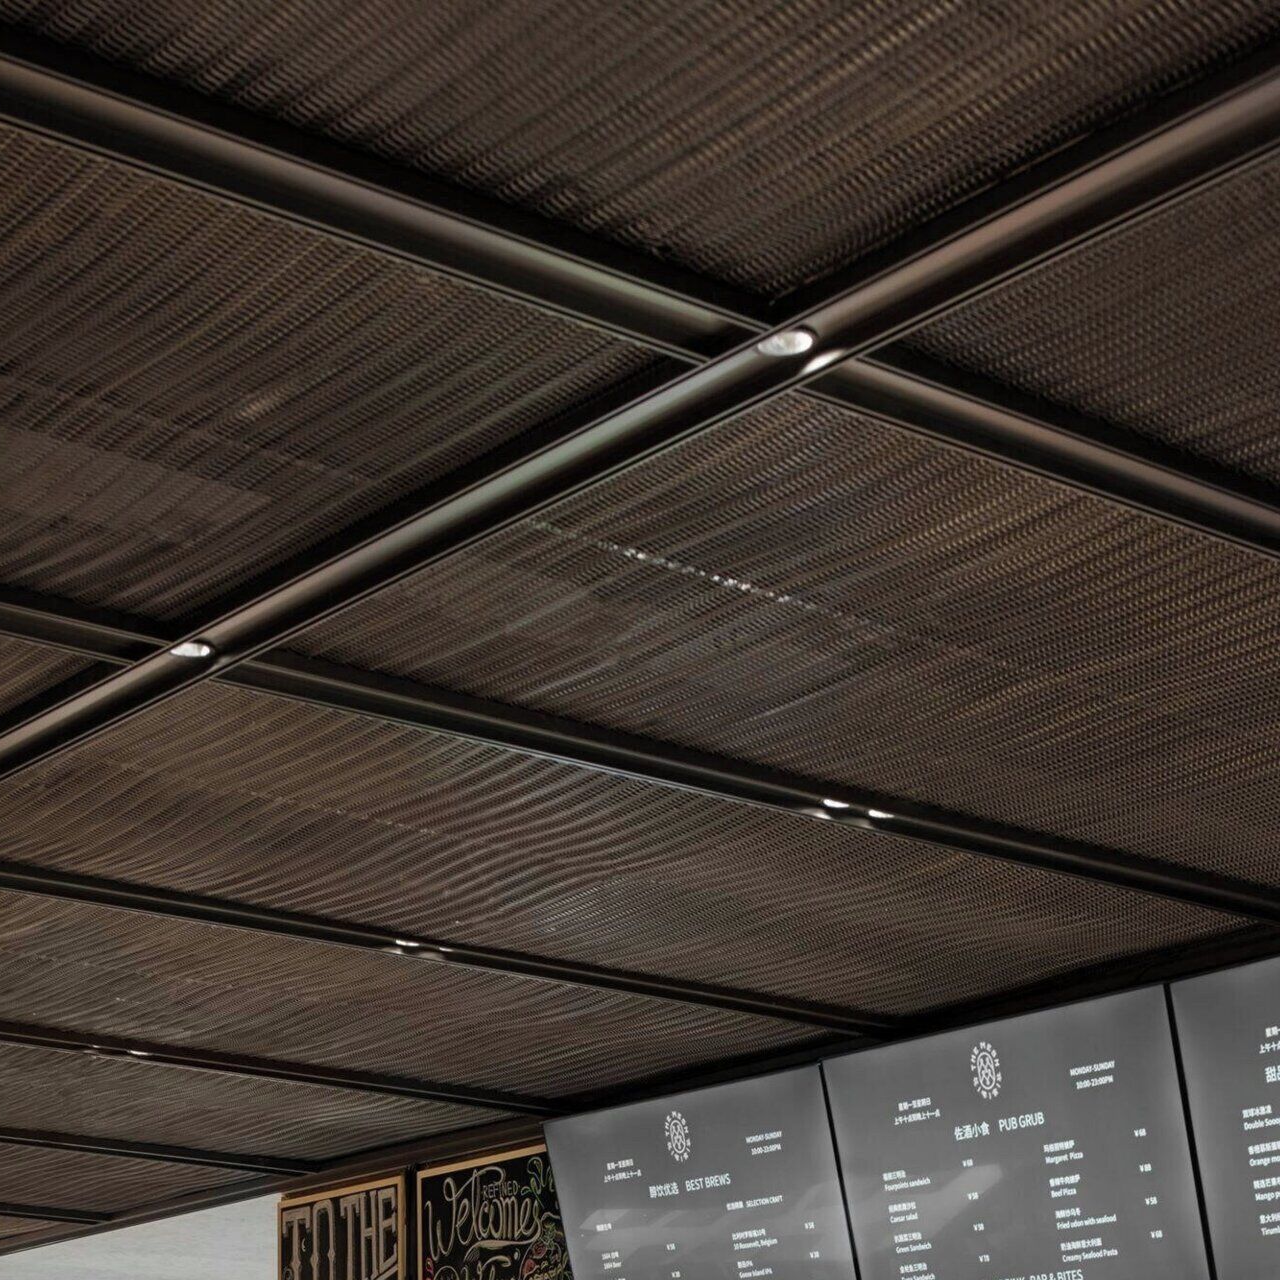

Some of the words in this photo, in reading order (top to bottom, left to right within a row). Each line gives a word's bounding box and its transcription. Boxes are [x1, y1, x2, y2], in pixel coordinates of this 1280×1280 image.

[1069, 1060, 1114, 1076] MONDAY-SUNDAY
[954, 1121, 989, 1140] 佐酒小食
[998, 1116, 1018, 1131] PUB
[1018, 1112, 1044, 1128] GRUB
[1243, 1119, 1264, 1130] Double
[1249, 1157, 1270, 1166] Orange
[685, 1177, 703, 1191] BEST
[704, 1173, 731, 1188] BREWS
[909, 1177, 930, 1187] sandwich
[482, 1180, 519, 1201] REFINED
[1051, 1188, 1062, 1198] Beef
[1255, 1192, 1275, 1201] Mango
[1056, 1220, 1070, 1230] Fried
[1083, 1217, 1096, 1225] with
[1095, 1214, 1116, 1224] seafood
[909, 1242, 931, 1251] Sandwich
[1062, 1254, 1082, 1262] Creamy
[1081, 1249, 1103, 1259] Seafood
[1102, 1248, 1118, 1256] Pasta
